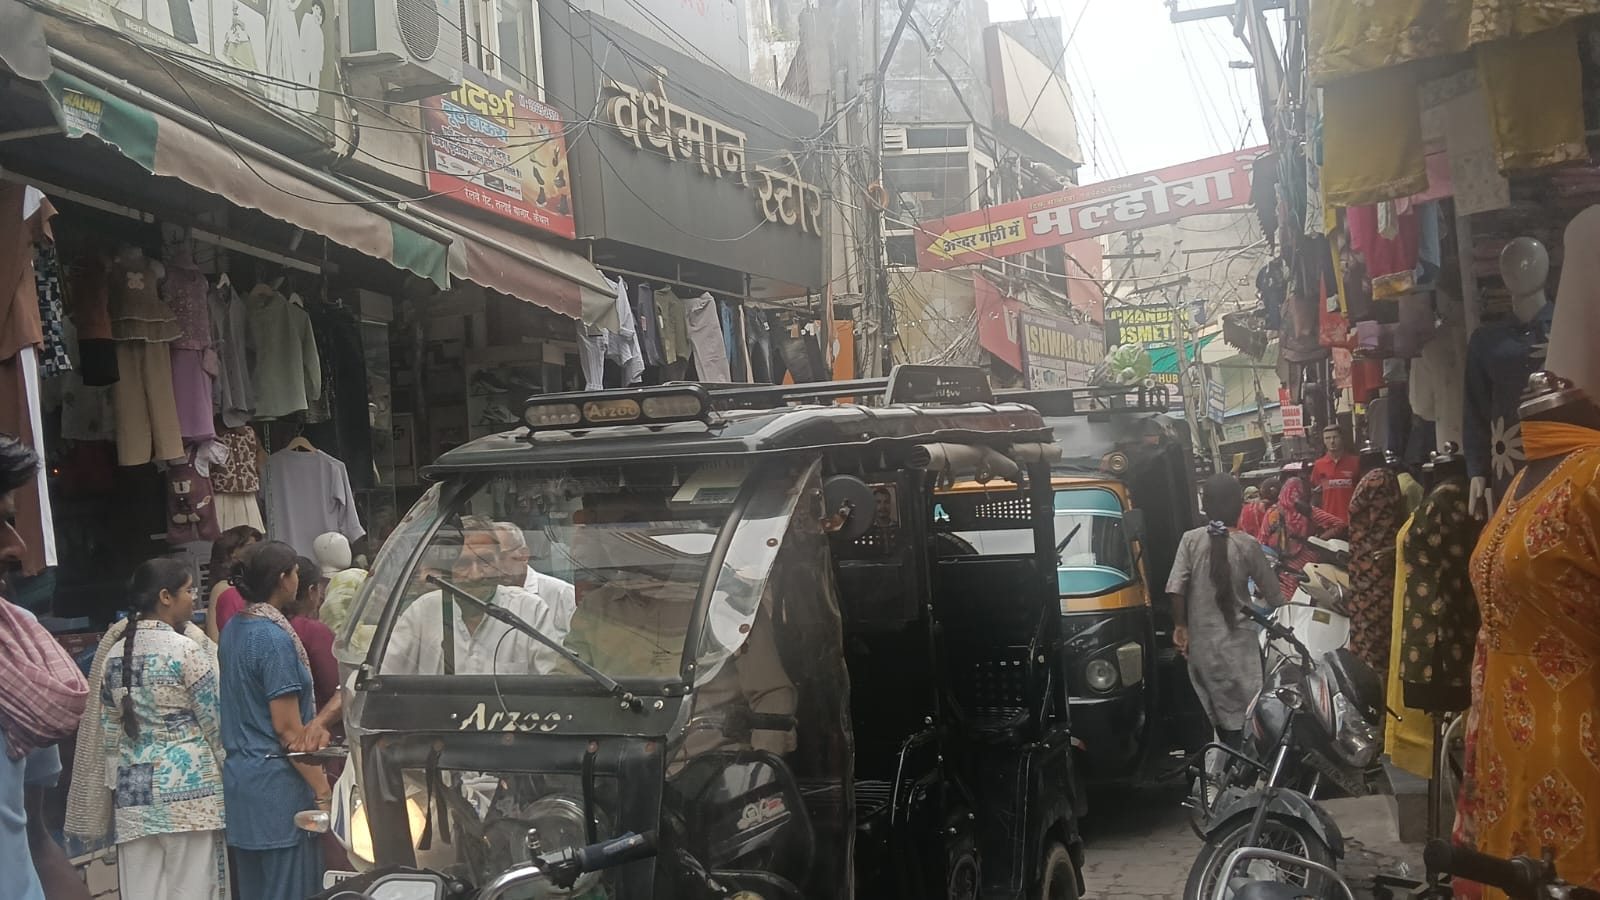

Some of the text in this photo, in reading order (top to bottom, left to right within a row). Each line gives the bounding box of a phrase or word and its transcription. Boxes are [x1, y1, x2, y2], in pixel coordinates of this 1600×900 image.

[450, 78, 515, 129] दर्श
[603, 65, 749, 188] वर्धमान
[754, 148, 822, 238] स्टोर
[1028, 167, 1235, 235] मल्होत्रा
[978, 223, 1008, 248] गली
[1025, 325, 1075, 360] ISHWAR
[1076, 341, 1084, 362] &
[1158, 373, 1179, 384] HUB
[590, 404, 636, 418] Arzoo
[459, 703, 561, 731] Arzoo
